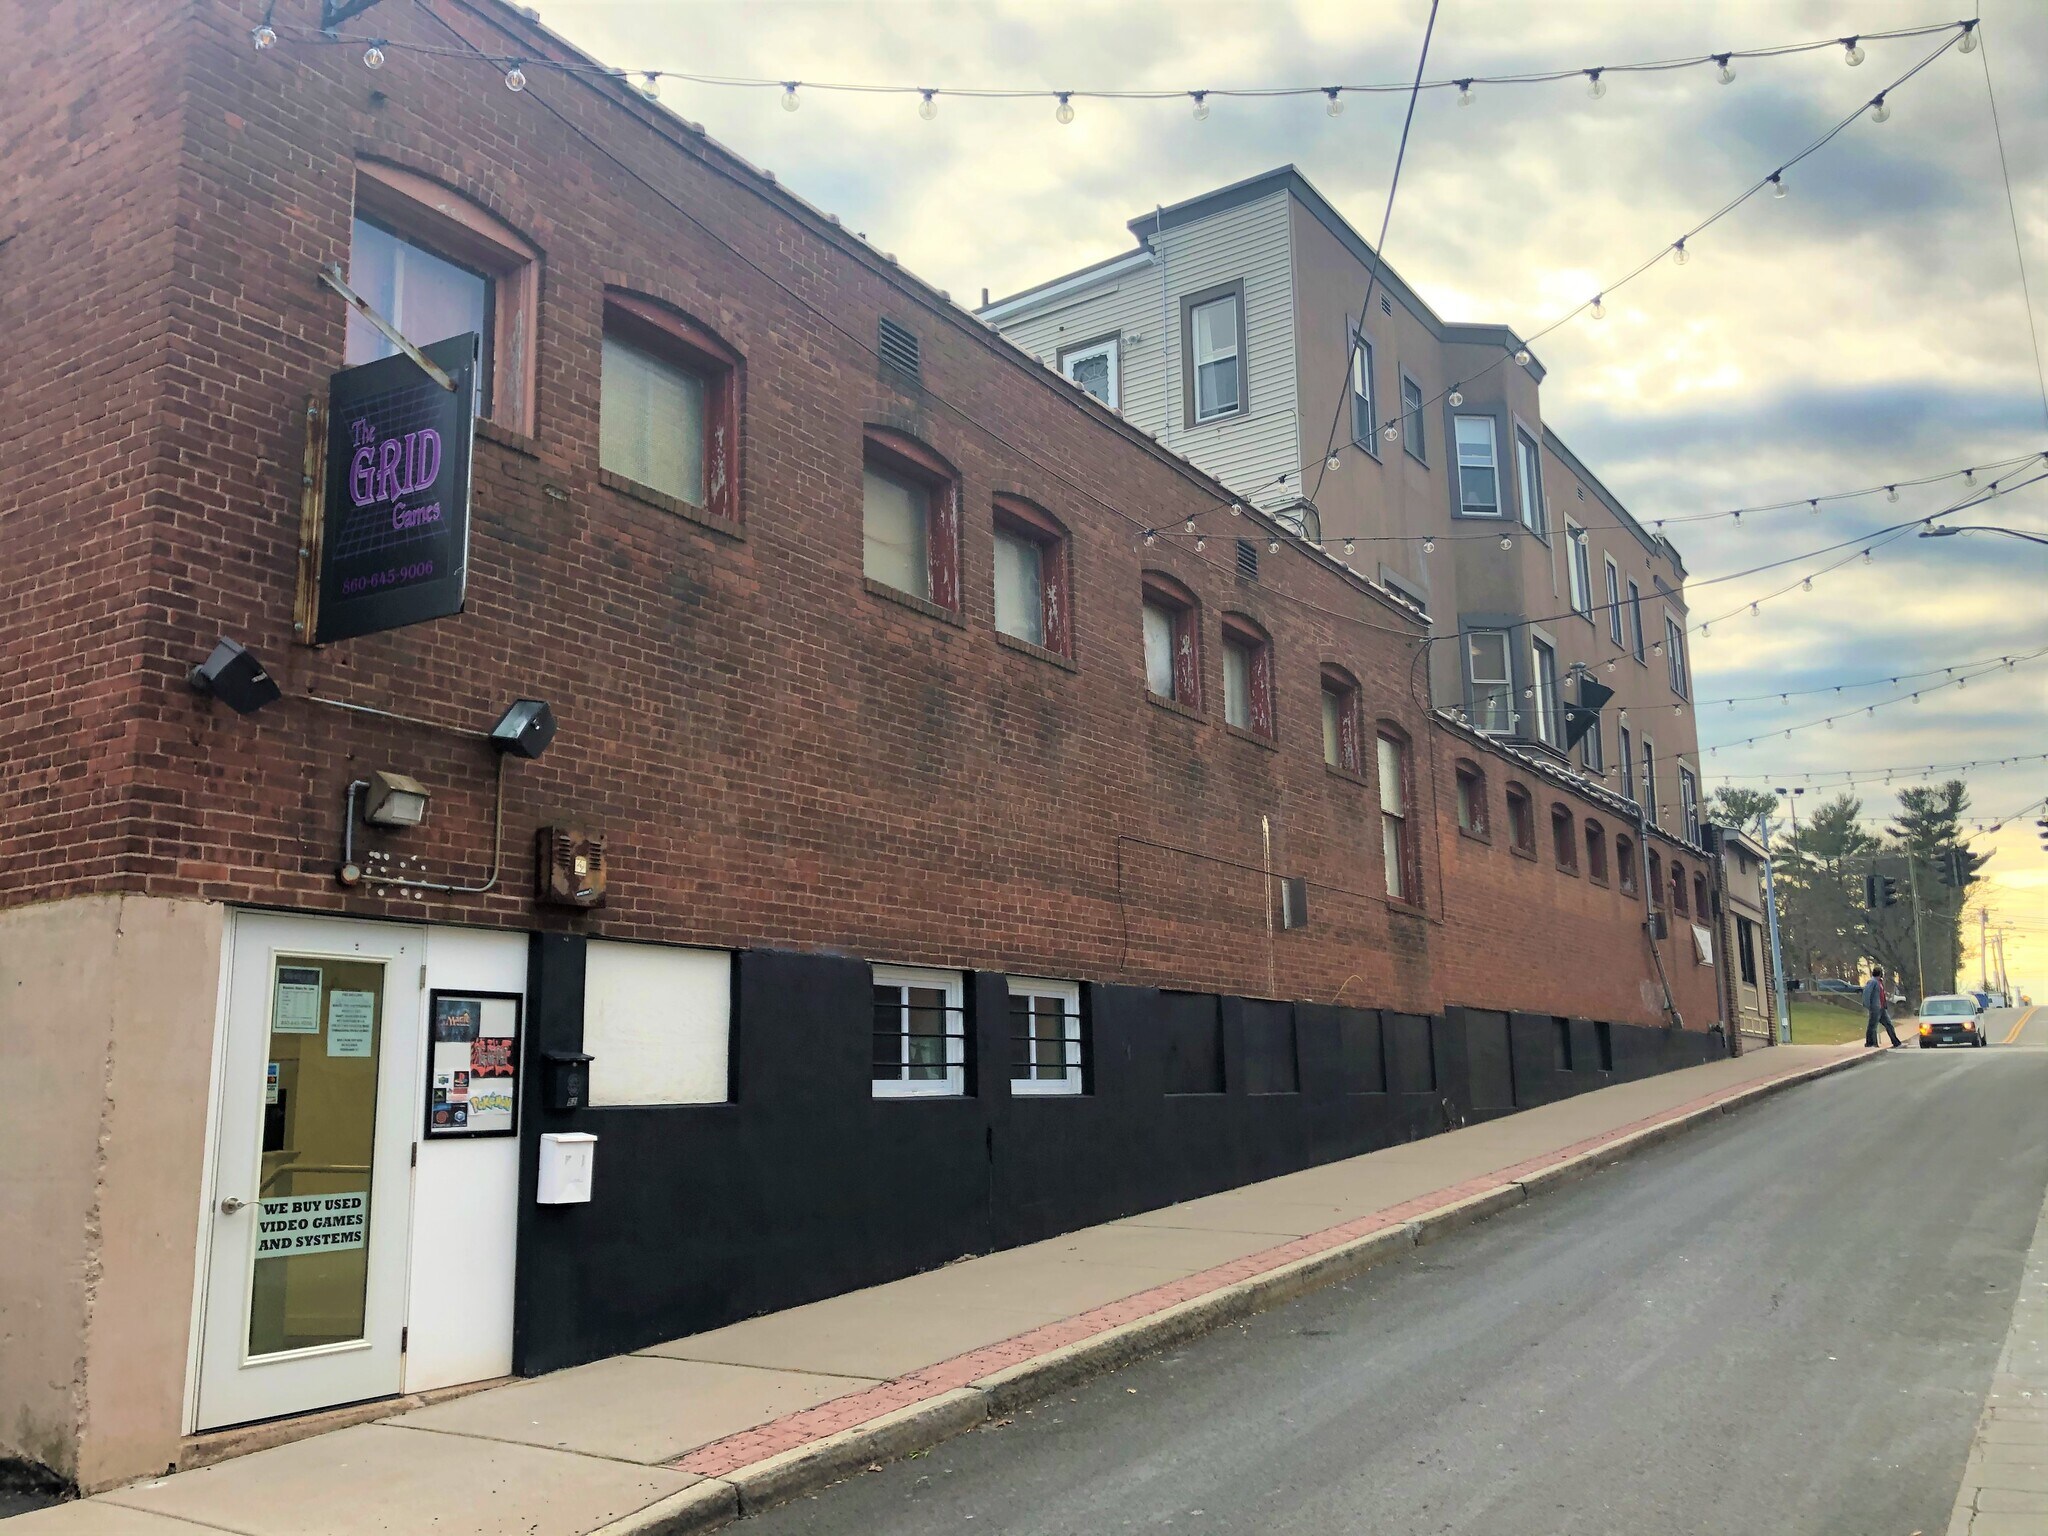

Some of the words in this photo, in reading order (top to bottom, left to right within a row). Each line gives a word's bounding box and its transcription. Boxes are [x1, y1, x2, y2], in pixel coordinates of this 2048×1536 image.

[351, 418, 376, 447] The
[349, 428, 441, 506] GRID
[392, 501, 441, 530] Games
[342, 561, 433, 594] 860-645-9006
[264, 1203, 288, 1215] WE
[291, 1200, 322, 1213] BUY
[324, 1197, 362, 1211] USED
[259, 1218, 309, 1233] VIDEO
[312, 1213, 363, 1229] GAMES
[258, 1237, 292, 1251] AND
[295, 1231, 362, 1247] SYSTEMS
